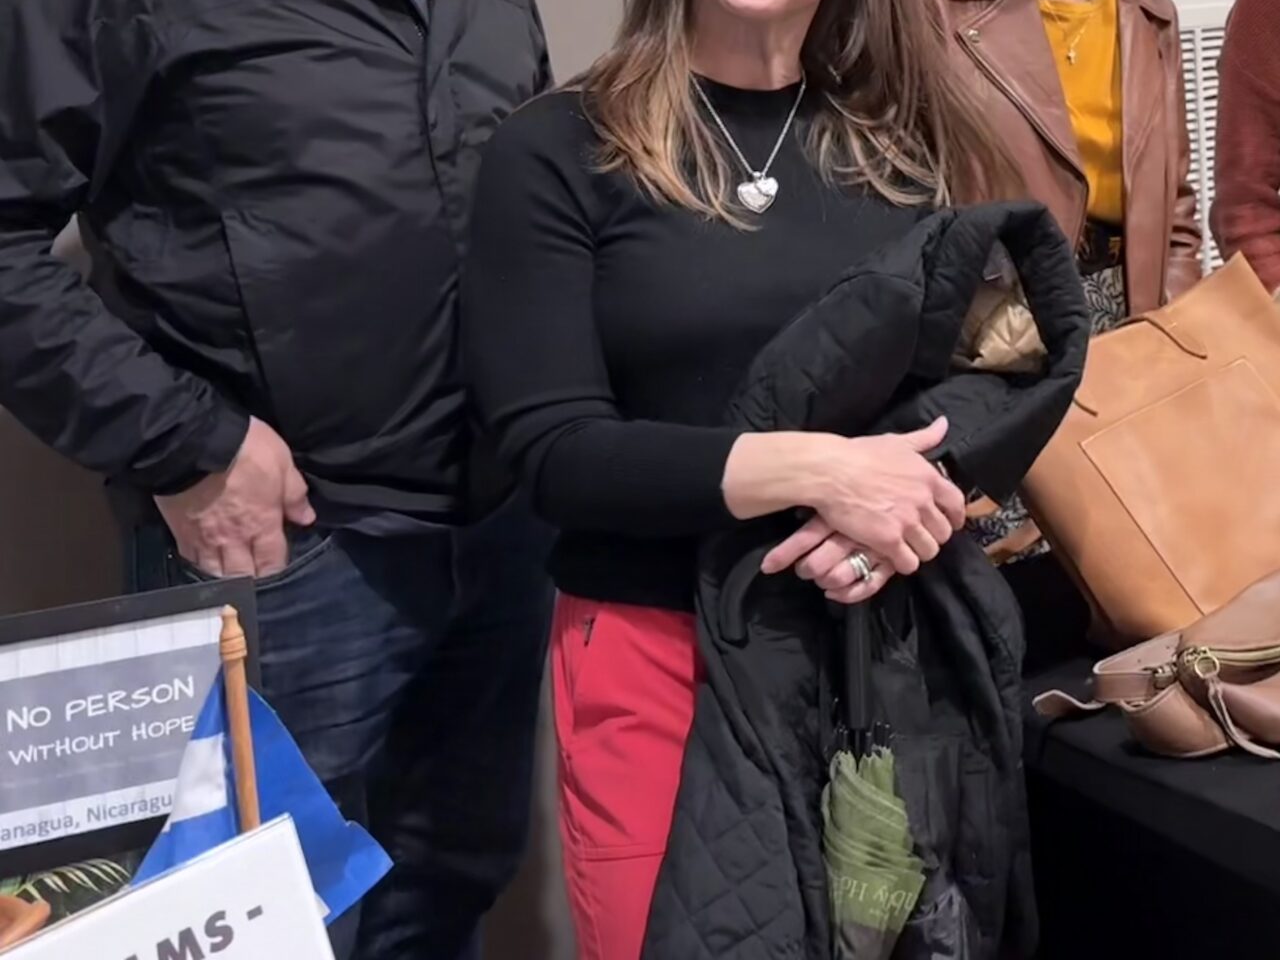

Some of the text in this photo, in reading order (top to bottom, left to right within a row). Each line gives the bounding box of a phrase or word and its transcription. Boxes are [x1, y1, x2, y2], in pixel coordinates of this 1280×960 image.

[6, 675, 195, 733] NO PERSON
[8, 715, 196, 766] WITHOUT HOPE
[0, 793, 173, 841] anagua, Nicaragu
[124, 910, 235, 960] MS
